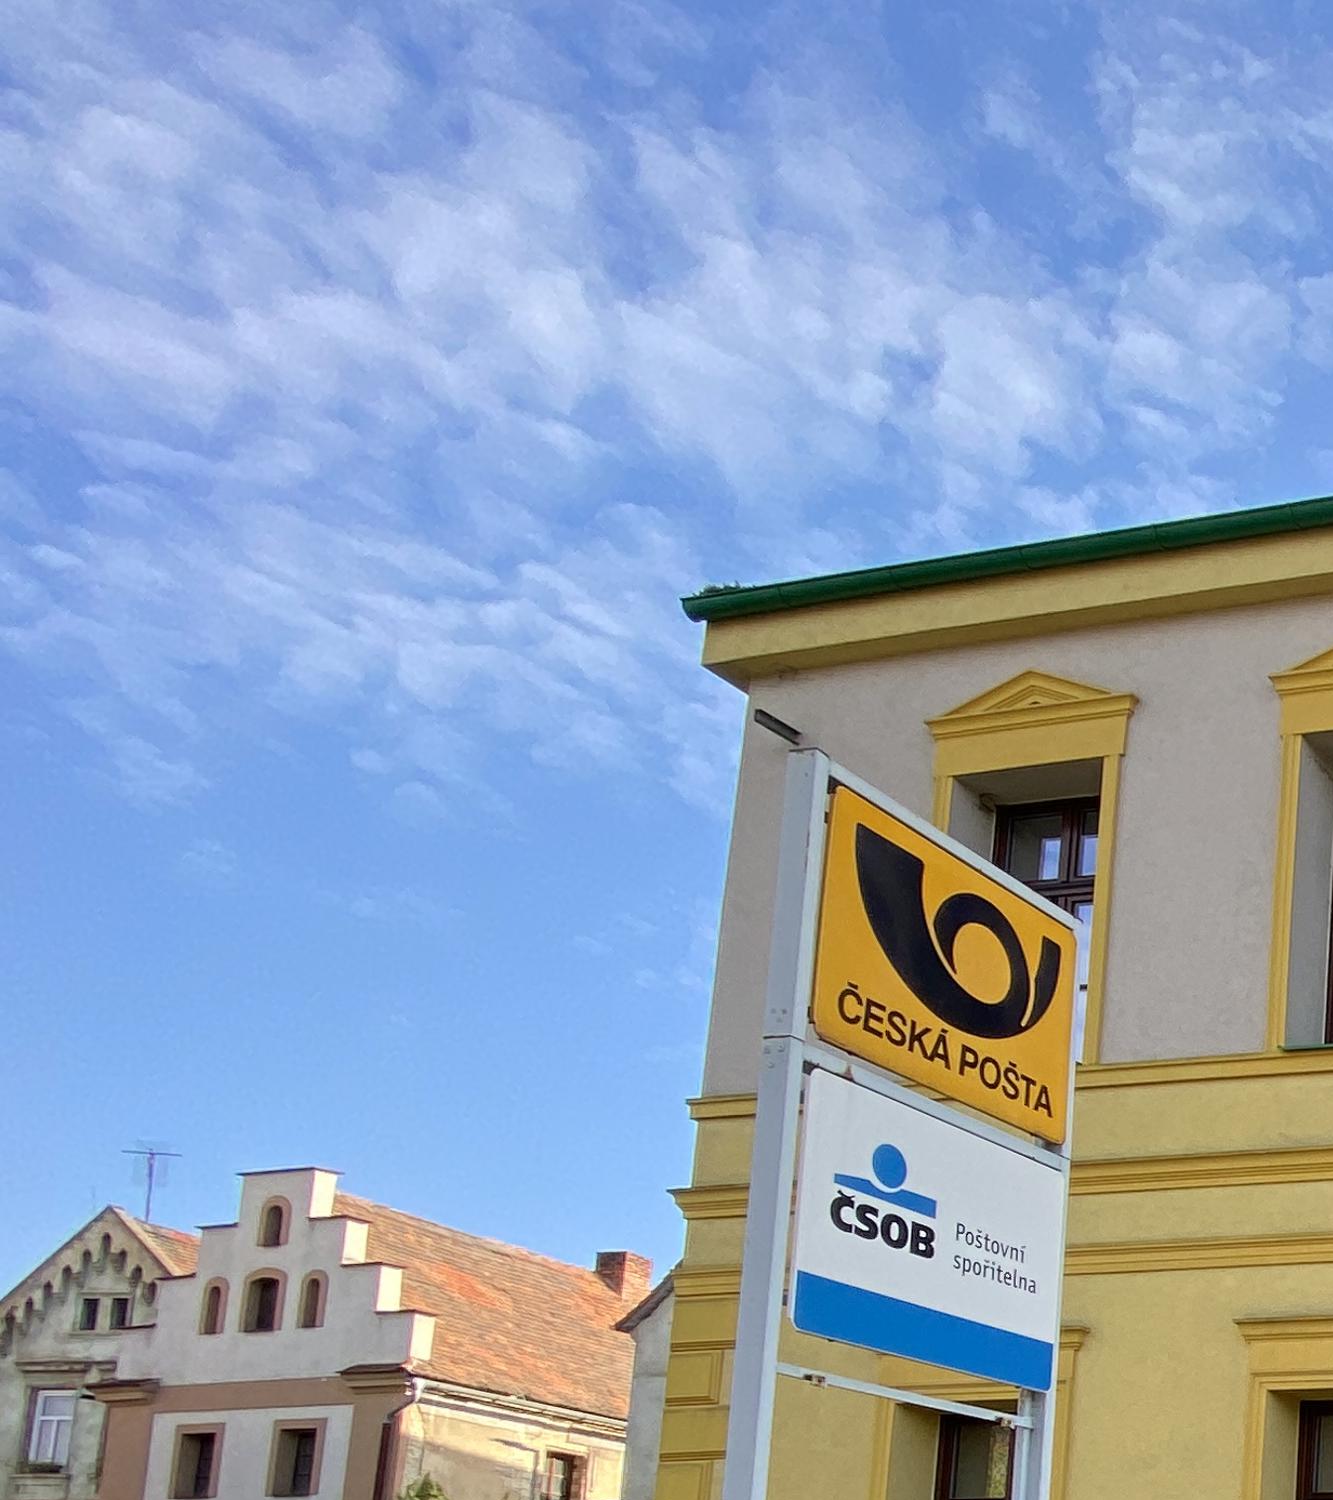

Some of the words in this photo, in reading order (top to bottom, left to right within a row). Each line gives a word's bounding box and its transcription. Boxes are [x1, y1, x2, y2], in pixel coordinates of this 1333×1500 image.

[838, 981, 951, 1070] ČESKÁ
[959, 1044, 1053, 1118] POŠTA
[830, 1189, 935, 1259] ČSOB
[956, 1223, 1026, 1263] Poštovní
[953, 1255, 1036, 1294] spořitelna
